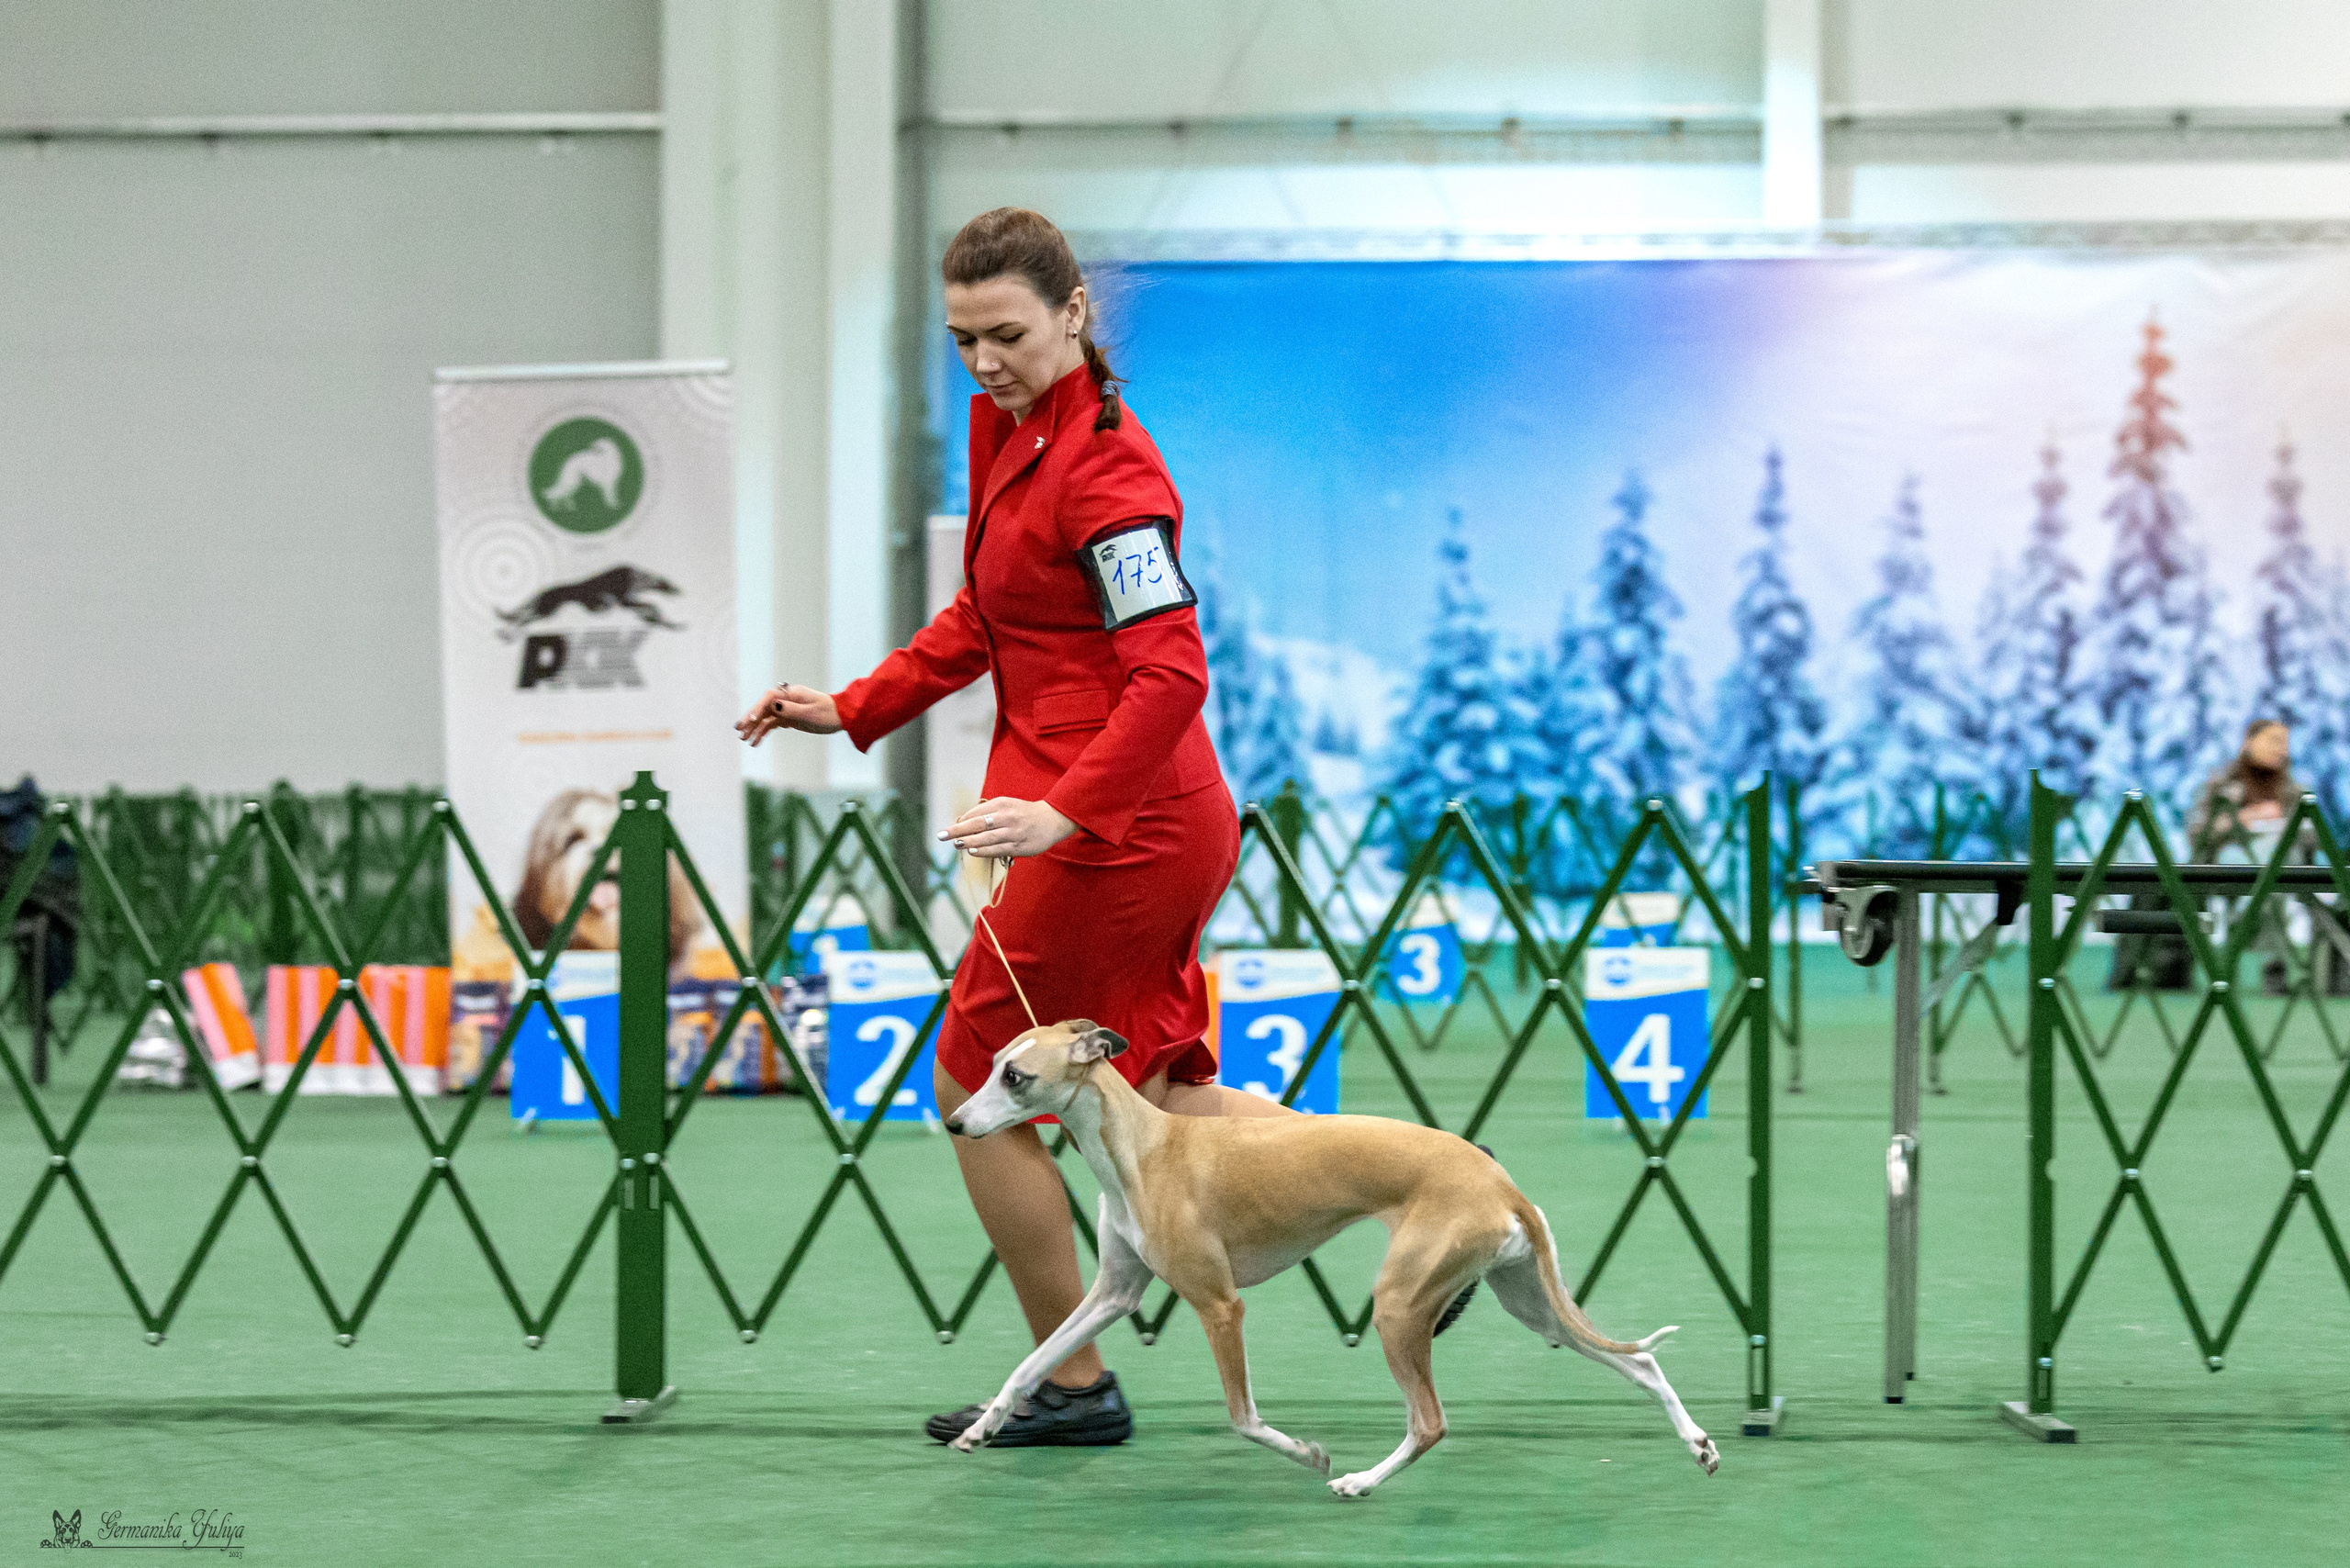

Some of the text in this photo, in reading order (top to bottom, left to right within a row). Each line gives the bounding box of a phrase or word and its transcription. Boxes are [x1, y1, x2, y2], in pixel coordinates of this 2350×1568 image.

[1113, 546, 1162, 596] 175
[1397, 933, 1442, 996] 3
[547, 1014, 587, 1105] 1
[855, 1014, 917, 1106] 2
[1243, 1014, 1307, 1103] 3
[1612, 1013, 1685, 1103] 4
